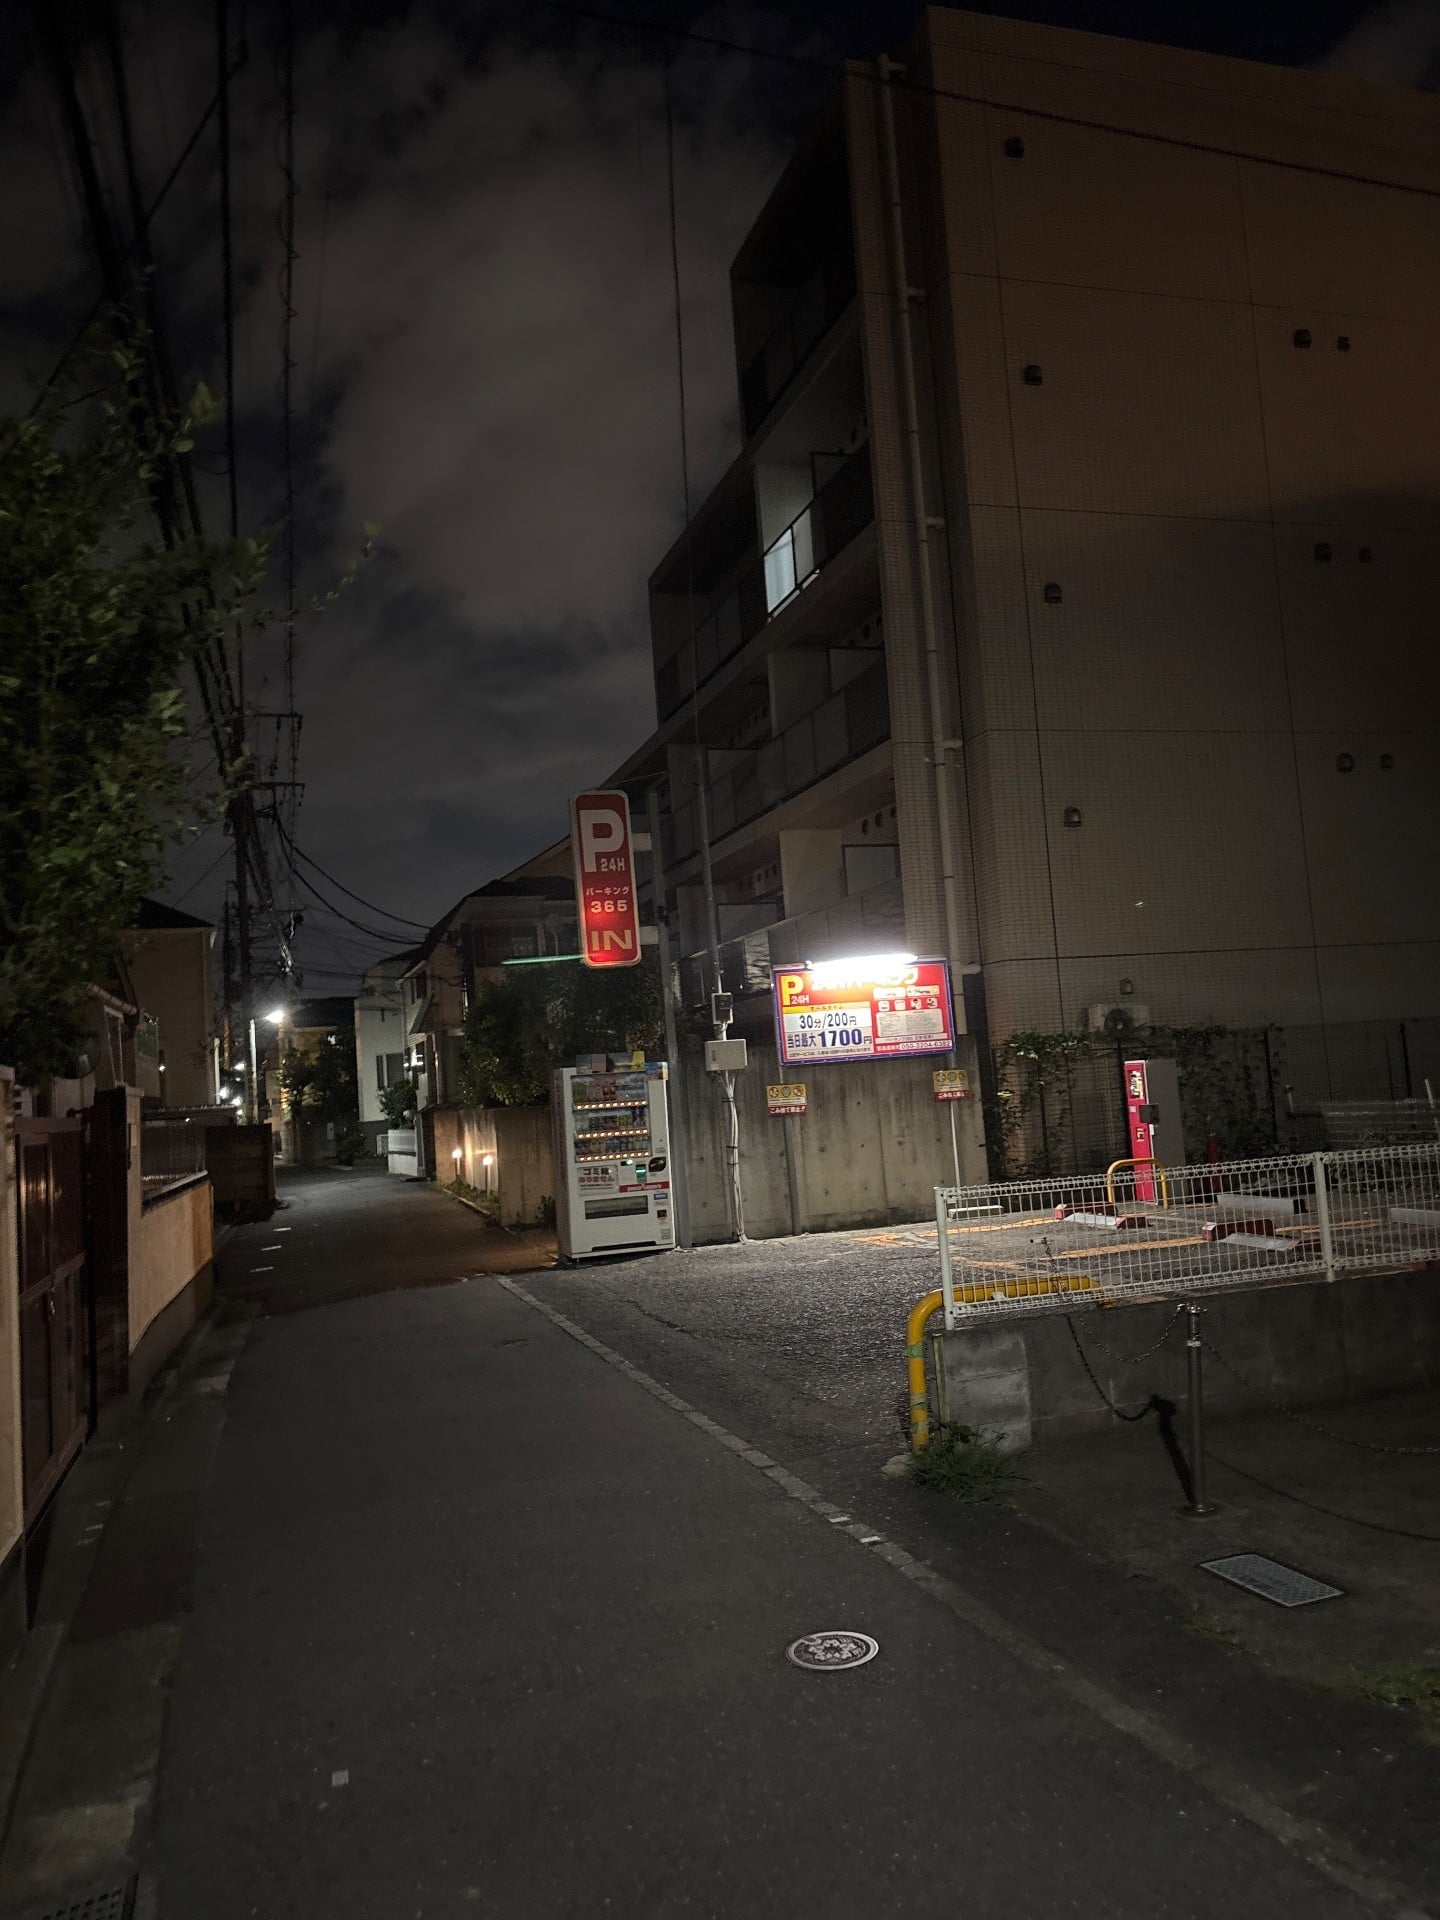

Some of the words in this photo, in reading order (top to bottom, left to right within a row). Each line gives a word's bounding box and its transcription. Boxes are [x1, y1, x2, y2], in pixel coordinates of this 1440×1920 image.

[580, 809, 625, 873] P
[600, 857, 626, 872] 24H
[590, 900, 628, 914] 365
[591, 929, 633, 951] IN
[781, 974, 804, 1006] P
[791, 995, 810, 1005] 24H
